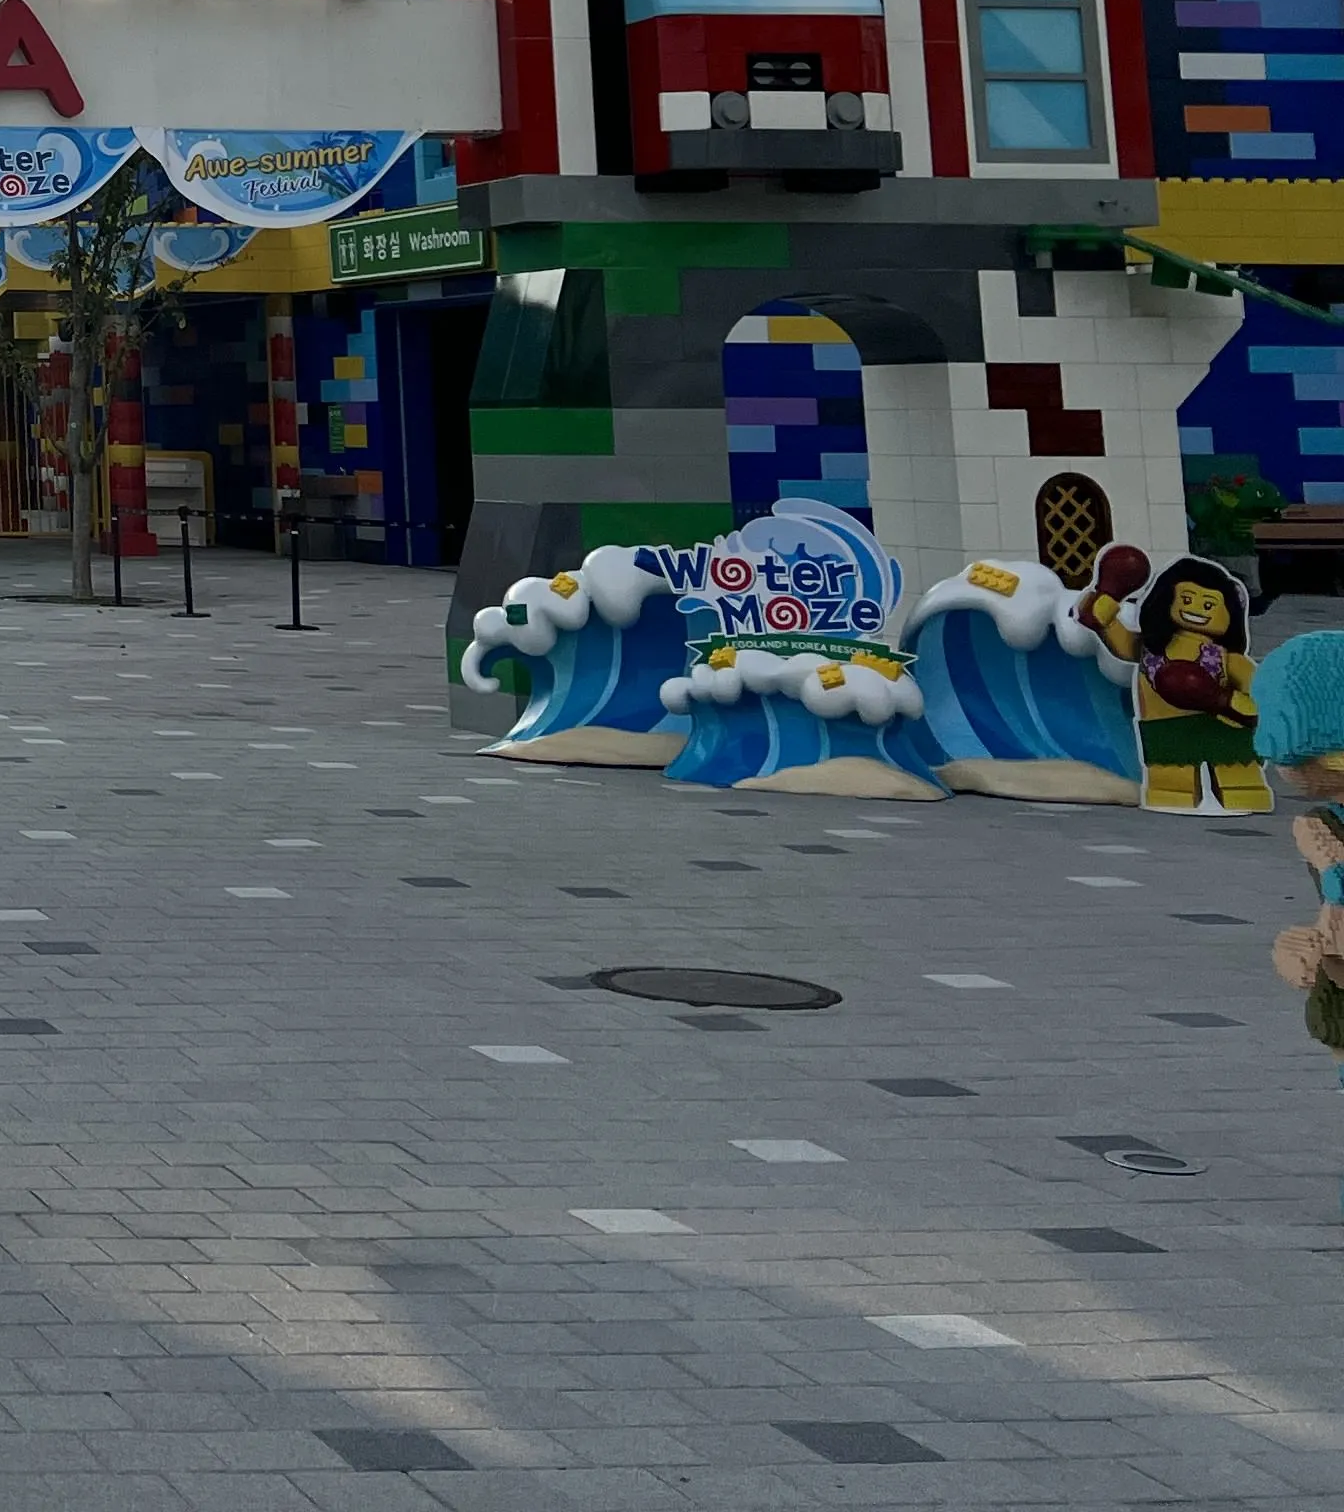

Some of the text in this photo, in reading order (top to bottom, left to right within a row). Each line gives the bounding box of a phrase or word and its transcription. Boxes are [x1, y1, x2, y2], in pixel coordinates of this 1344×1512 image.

[185, 139, 373, 182] Awe-summer
[242, 171, 321, 203] Festival
[363, 227, 471, 262] 화장실 Washroom
[658, 546, 856, 595] Water
[716, 592, 882, 637] Maze
[791, 641, 828, 652] KOREA
